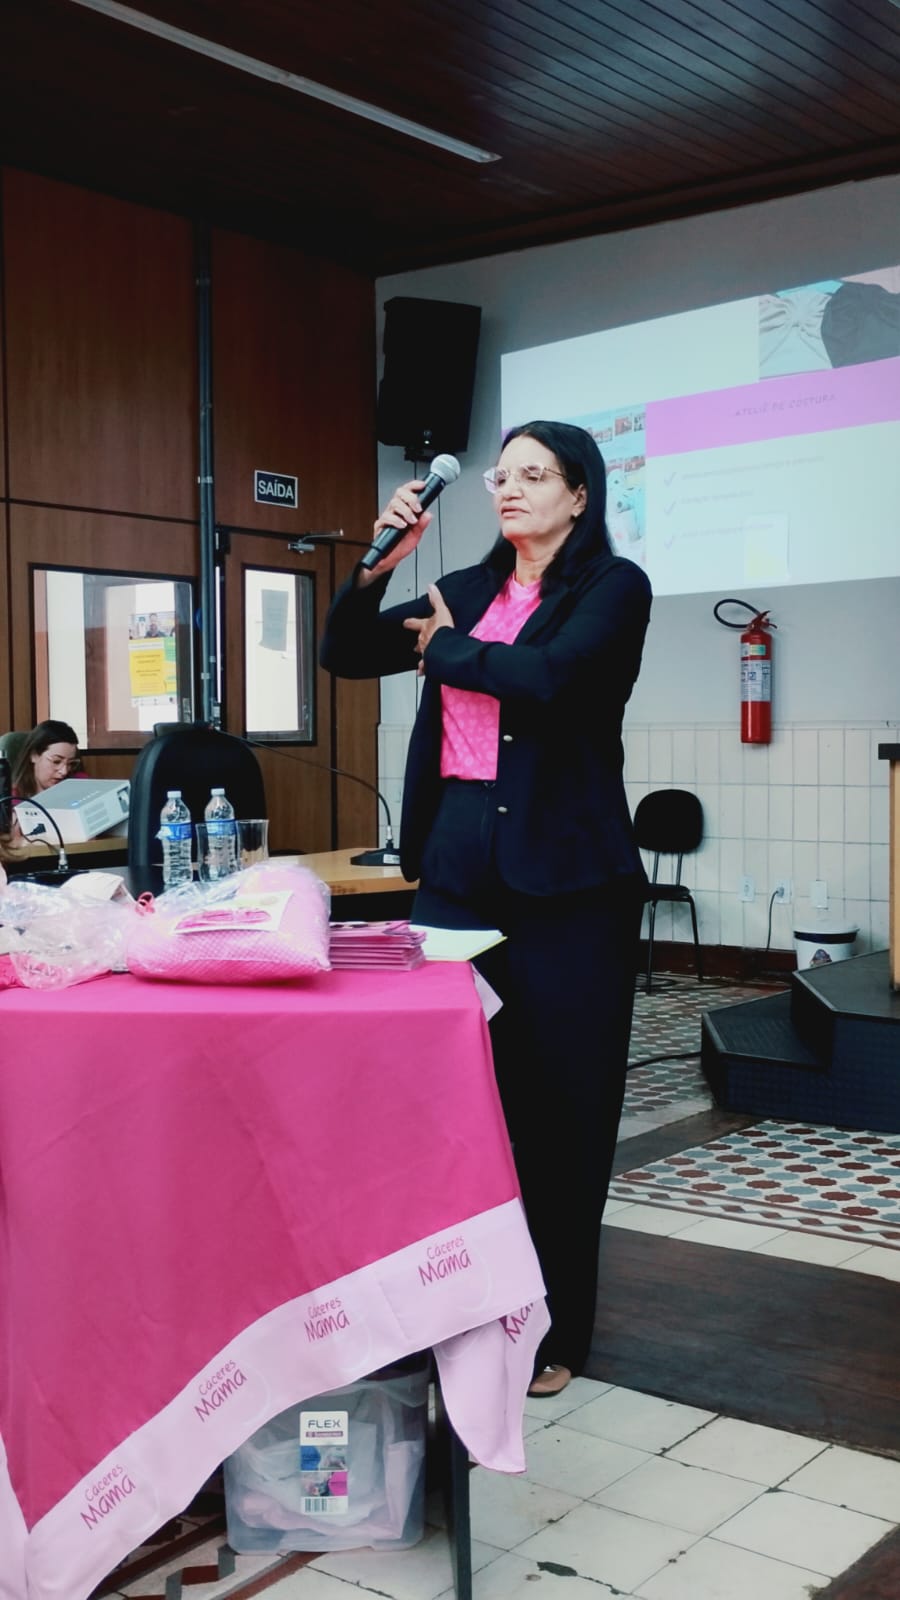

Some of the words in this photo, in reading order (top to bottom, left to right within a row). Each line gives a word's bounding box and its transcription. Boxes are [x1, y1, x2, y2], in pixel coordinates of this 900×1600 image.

[258, 479, 294, 499] SAÍDA
[418, 1249, 472, 1286] Mama
[304, 1309, 350, 1342] Mama
[194, 1369, 247, 1423] Mama
[308, 1420, 340, 1428] FLEX
[80, 1474, 136, 1530] Mama
